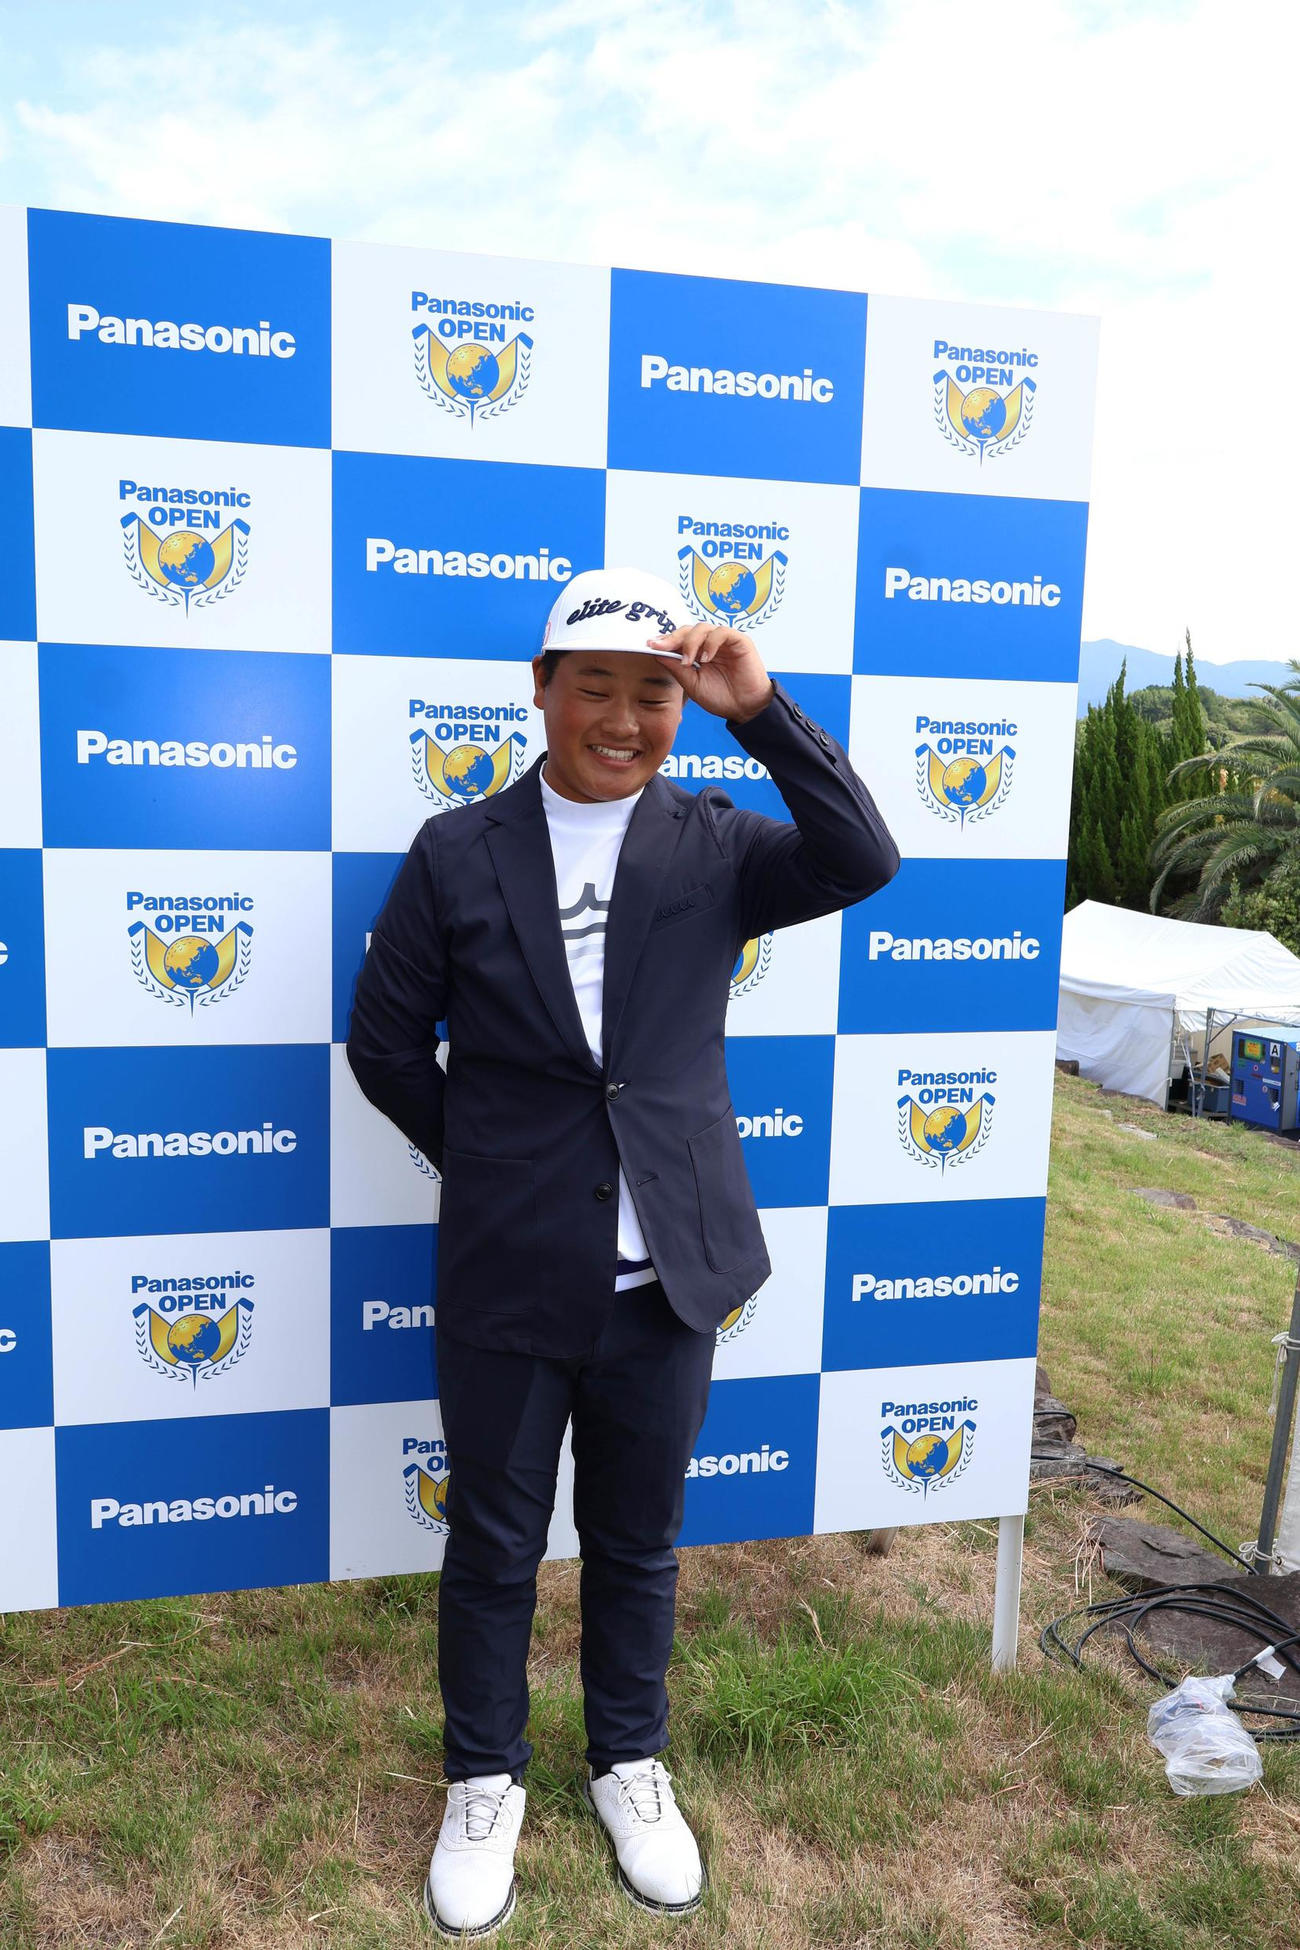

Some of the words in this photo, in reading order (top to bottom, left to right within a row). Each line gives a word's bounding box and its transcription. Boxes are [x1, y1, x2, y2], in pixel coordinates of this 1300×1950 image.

[412, 292, 534, 321] Panasonic
[68, 304, 296, 358] Panasonic
[438, 319, 505, 342] OPEN
[934, 340, 1038, 367] Panasonic
[641, 355, 833, 402] Panasonic
[956, 365, 1013, 386] OPEN
[120, 480, 250, 507] Panasonic
[149, 507, 220, 528] OPEN
[678, 516, 789, 540] Panasonic
[367, 538, 571, 582] Panasonic
[702, 540, 762, 560] OPEN
[885, 568, 1060, 606] Panasonic
[567, 598, 629, 625] elite
[625, 602, 676, 634] grip
[410, 700, 527, 721] Panasonic
[435, 723, 500, 742] OPEN
[916, 716, 1017, 736] Panasonic
[77, 730, 297, 769] Panasonic
[937, 738, 992, 755] OPEN
[657, 754, 773, 780] anaso
[127, 892, 253, 911] Panasonic
[155, 915, 224, 932] OPEN
[869, 931, 1039, 960] Panasonic
[1271, 1044, 1279, 1056] A
[898, 1068, 996, 1085] Panasonic
[919, 1088, 973, 1104] OPEN
[84, 1123, 296, 1158] Panasonic
[132, 1271, 254, 1293] Panasonic
[852, 1267, 1018, 1301] Panasonic
[159, 1293, 226, 1312] OPEN
[882, 1397, 977, 1417] Panasonic
[902, 1416, 954, 1433] OPEN
[403, 1438, 447, 1454] Pan
[91, 1485, 297, 1528] Panasonic
